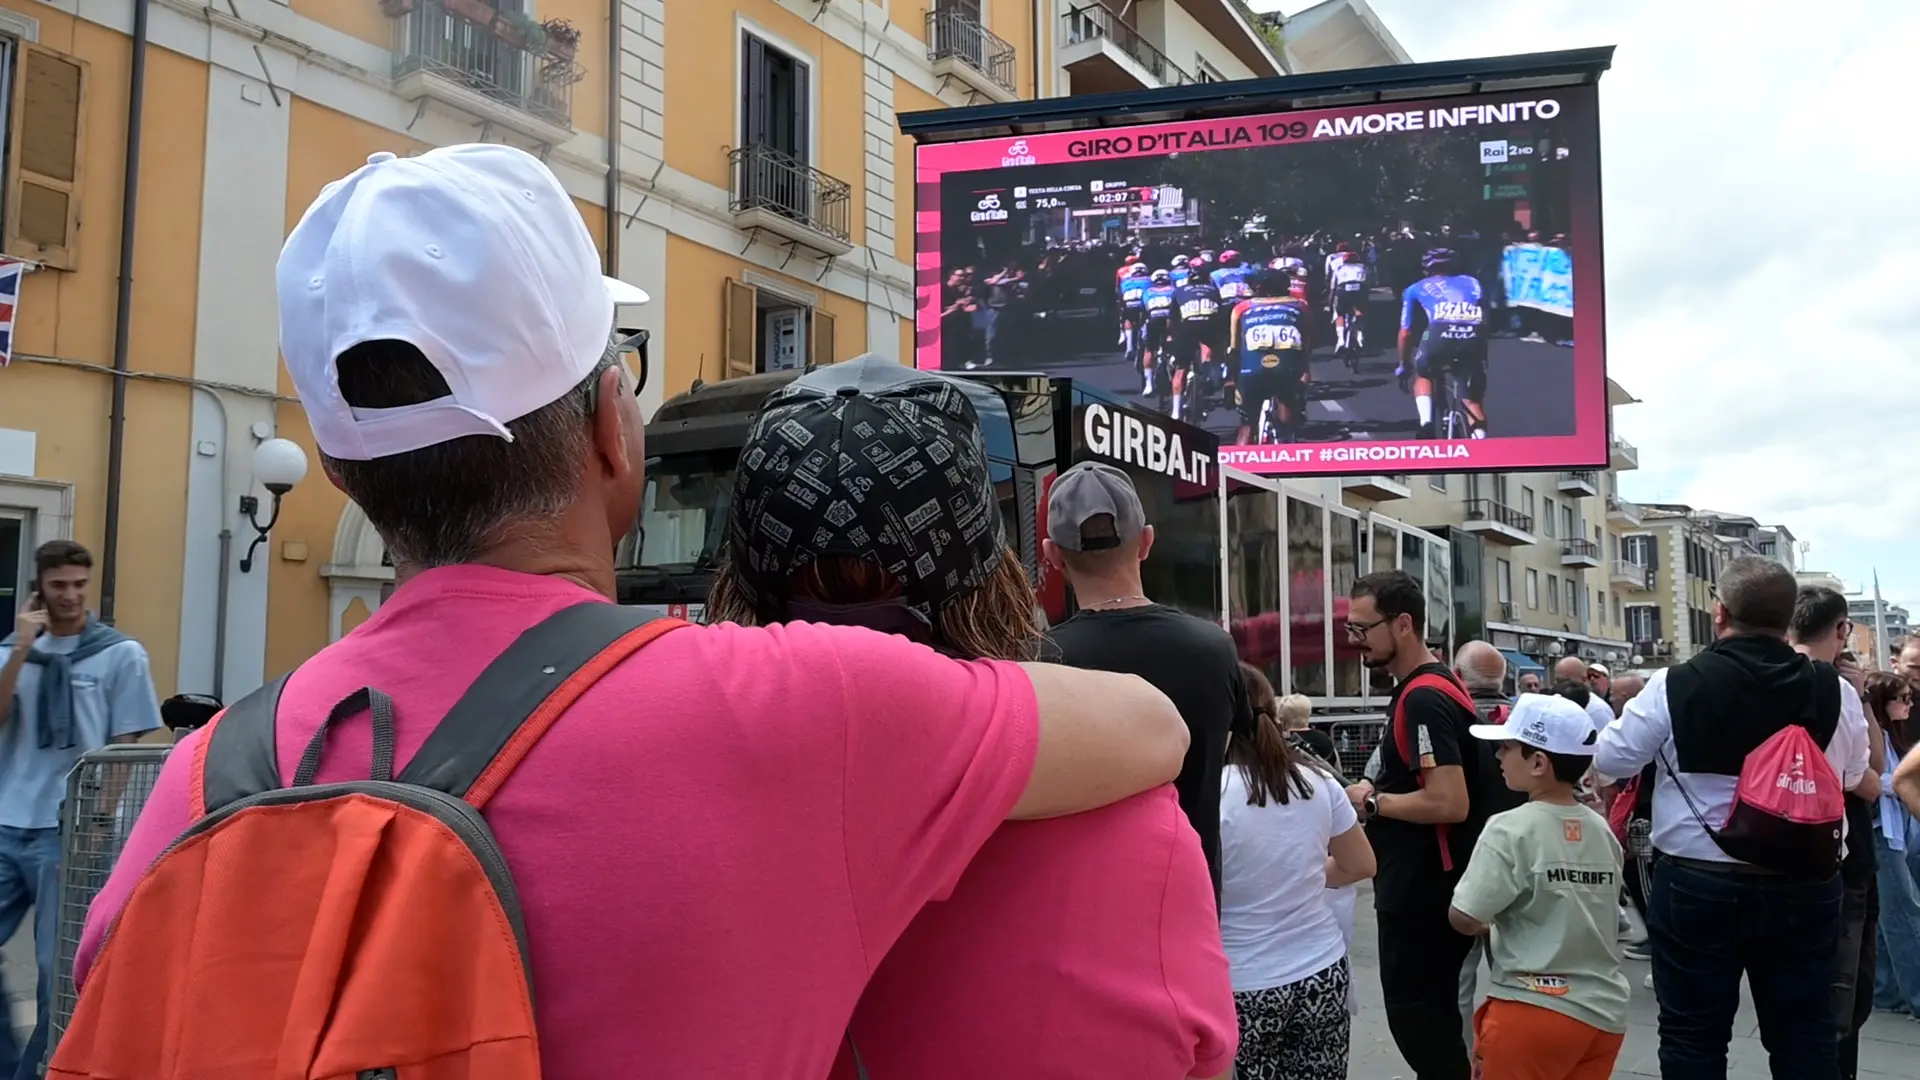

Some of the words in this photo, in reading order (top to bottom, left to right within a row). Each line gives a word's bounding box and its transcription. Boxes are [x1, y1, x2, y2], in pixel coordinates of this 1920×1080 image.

[1068, 136, 1132, 158] GIRO
[1257, 121, 1308, 141] 109
[1312, 110, 1424, 138] AMORE
[1429, 99, 1560, 129] INFINITO
[1484, 145, 1504, 157] Rai
[1093, 192, 1128, 203] +02:07
[1280, 328, 1297, 344] 64
[1084, 403, 1210, 486] GIRBA.IT
[1319, 444, 1469, 462] #GIRODITALIA
